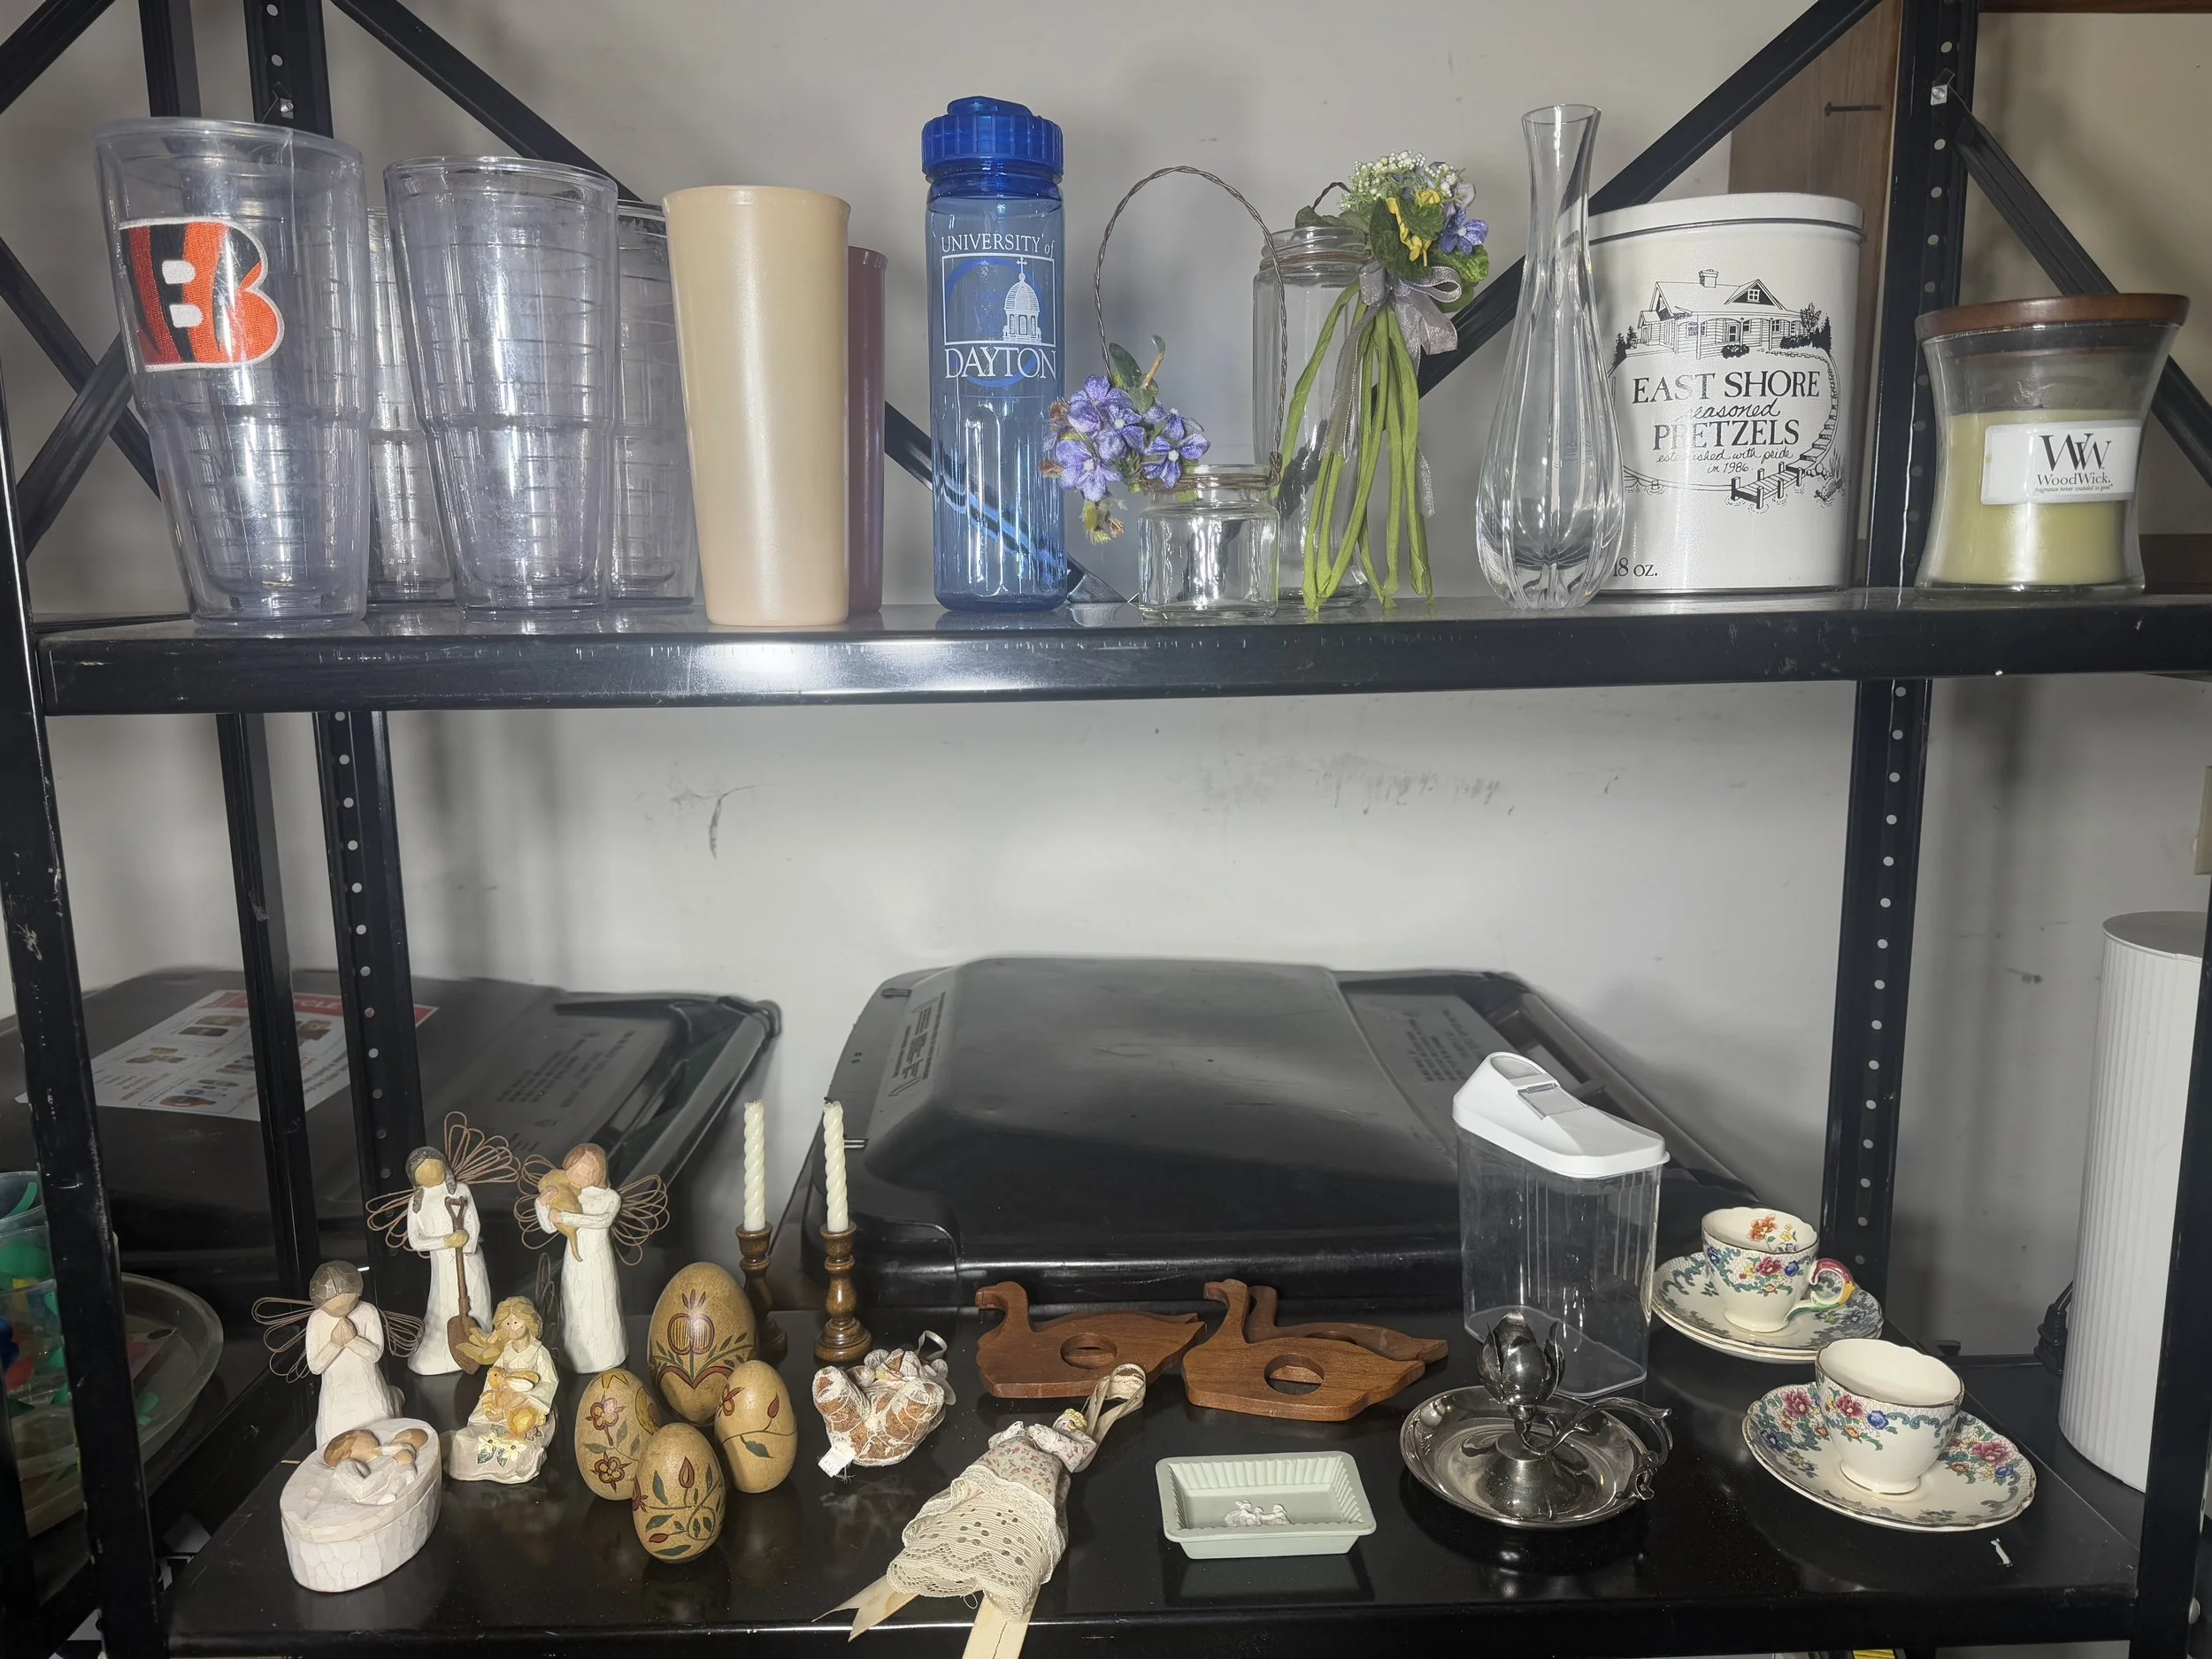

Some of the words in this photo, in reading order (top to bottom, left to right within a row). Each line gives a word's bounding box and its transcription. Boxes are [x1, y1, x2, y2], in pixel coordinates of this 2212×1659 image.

[941, 233, 1041, 253] UNIVERSITY
[1044, 240, 1056, 259] of
[944, 346, 1056, 380] DAYTON
[1632, 373, 1716, 404] EAST
[1724, 370, 1821, 398] SHORE
[1655, 449, 1731, 464] estaished
[1732, 447, 1761, 460] with
[1760, 446, 1793, 465] pride
[1707, 463, 1720, 473] in
[1632, 564, 1658, 577] oz.
